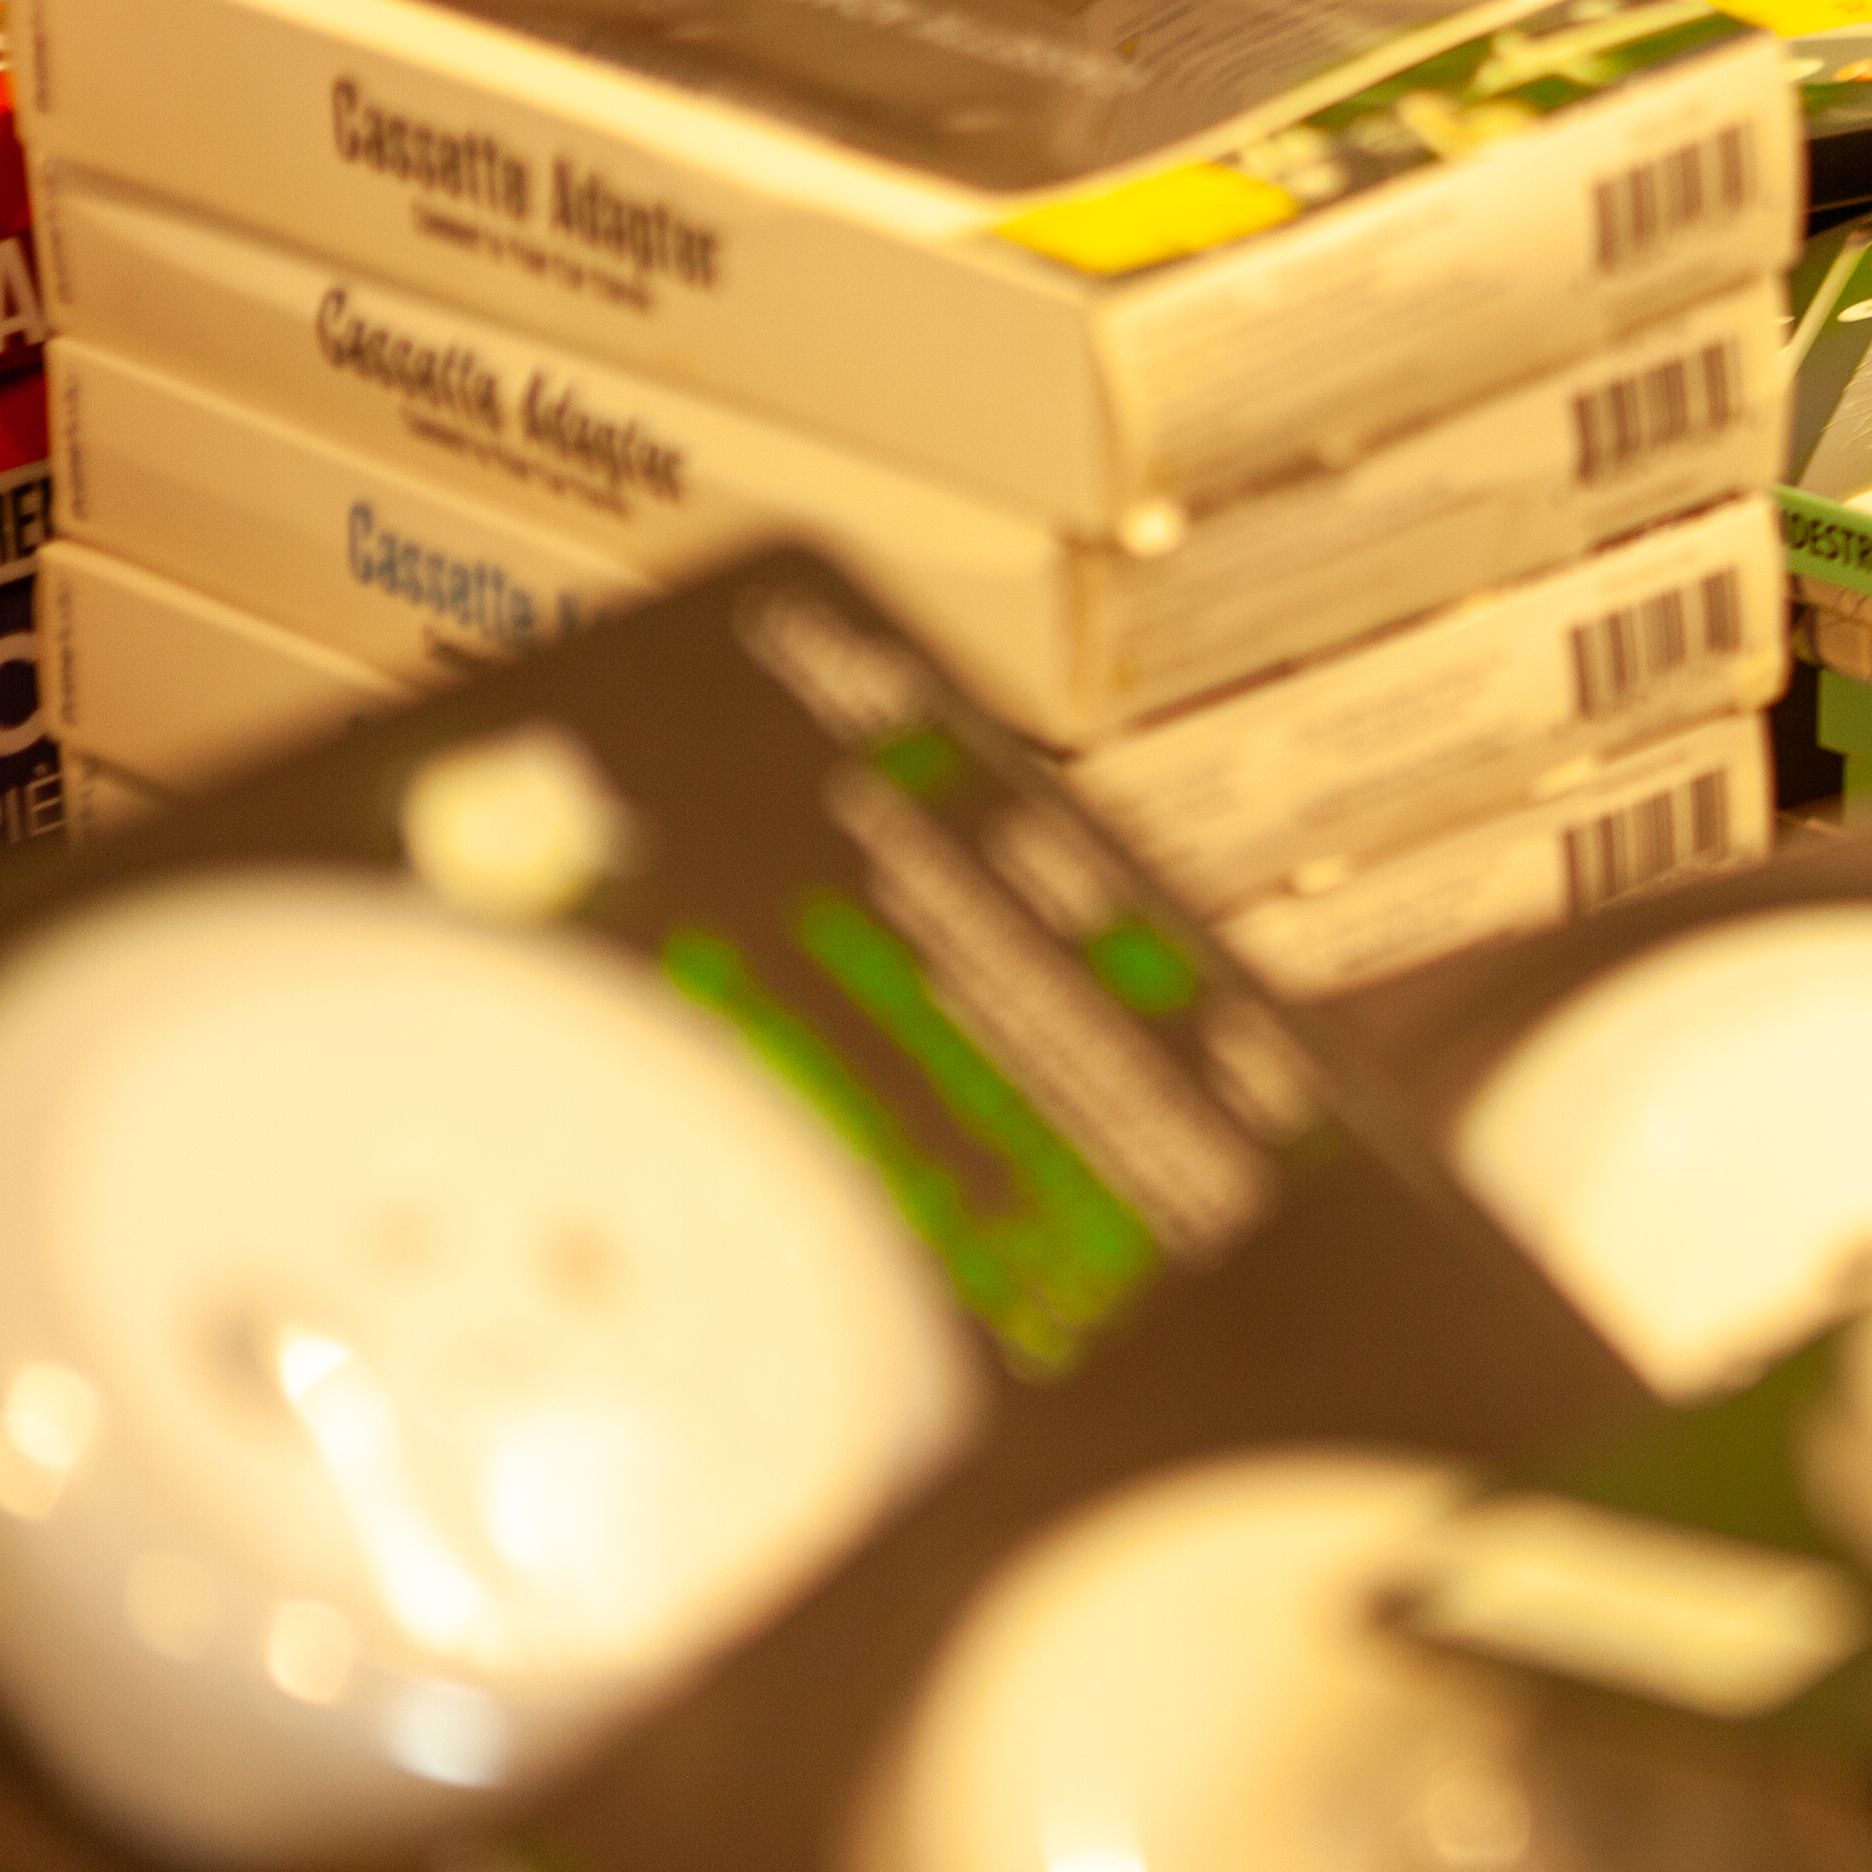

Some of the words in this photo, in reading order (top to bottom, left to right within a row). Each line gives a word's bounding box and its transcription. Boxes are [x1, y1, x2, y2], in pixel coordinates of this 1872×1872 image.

[332, 73, 531, 221] Cassette
[550, 143, 722, 291] Adapter
[315, 285, 504, 435] Cassette
[522, 370, 686, 507] Adapter
[346, 502, 539, 646] Cassette
